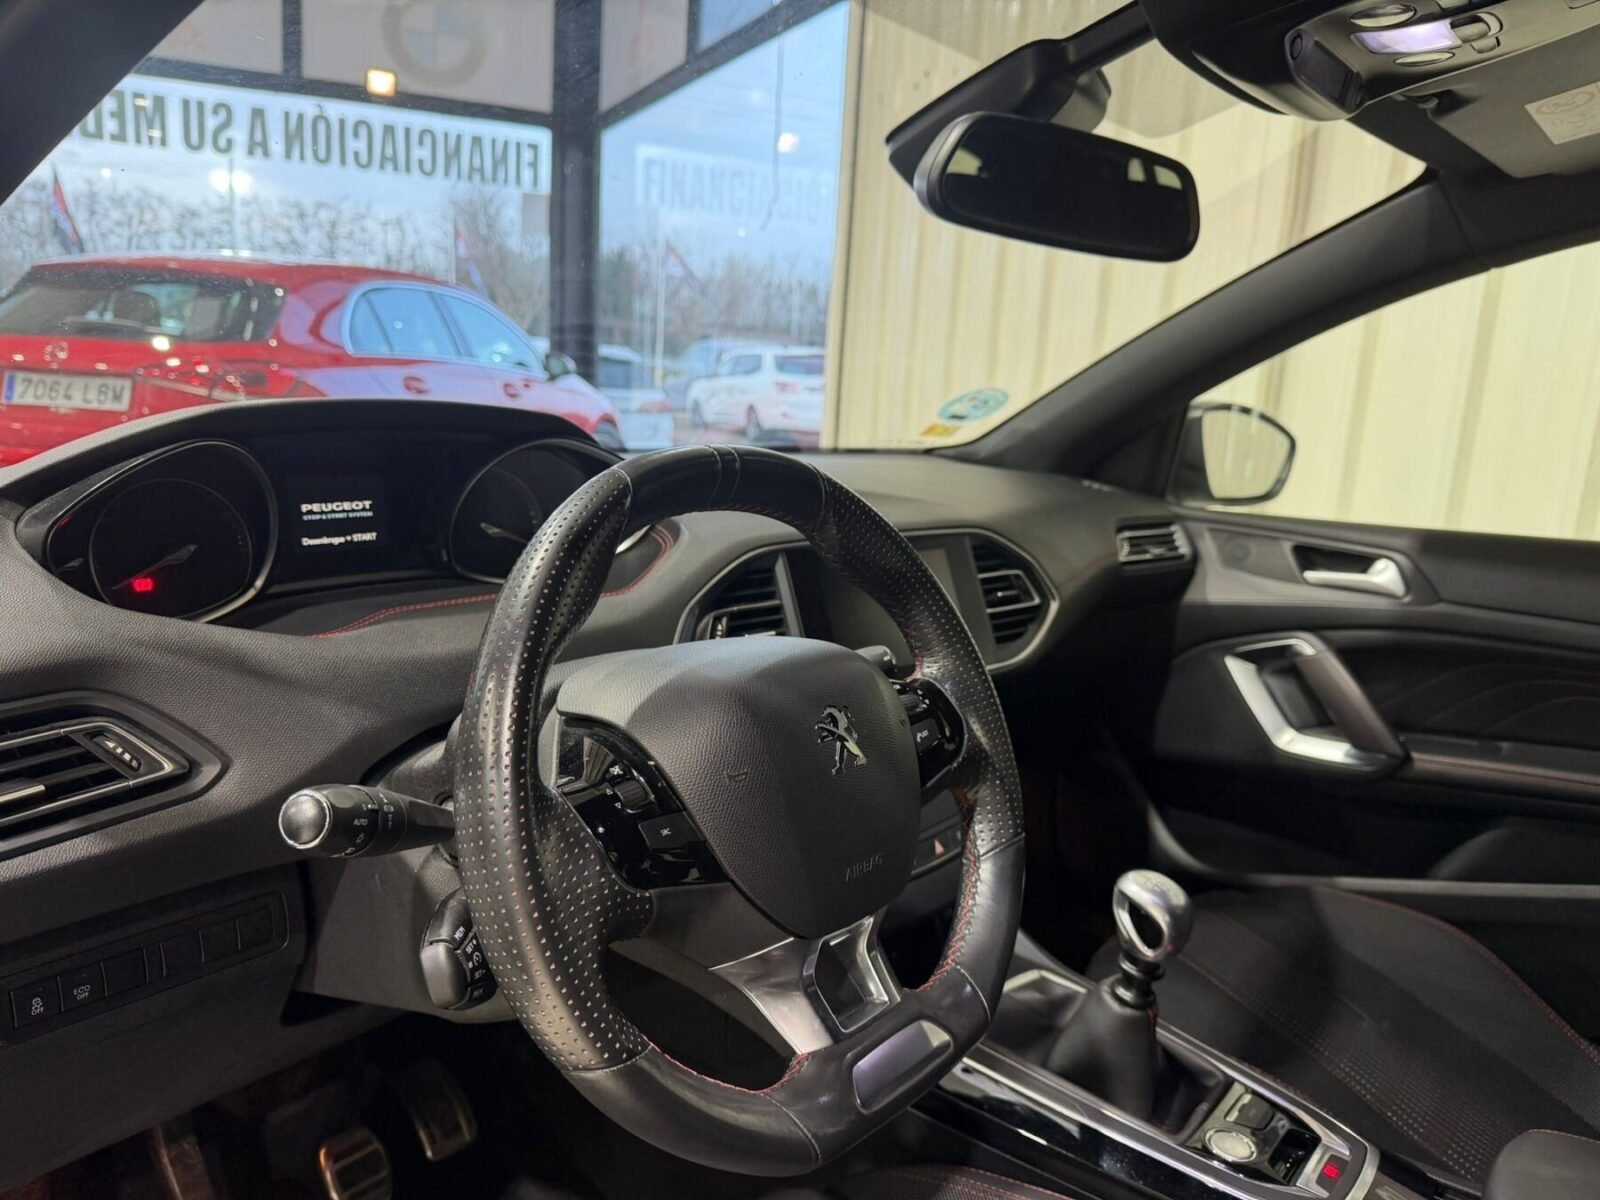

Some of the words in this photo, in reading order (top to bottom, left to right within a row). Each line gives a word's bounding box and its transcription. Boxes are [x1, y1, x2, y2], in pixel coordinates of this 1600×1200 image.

[300, 500, 373, 513] PEUGEOT
[353, 818, 368, 826] AUTO
[73, 984, 91, 996] ECO
